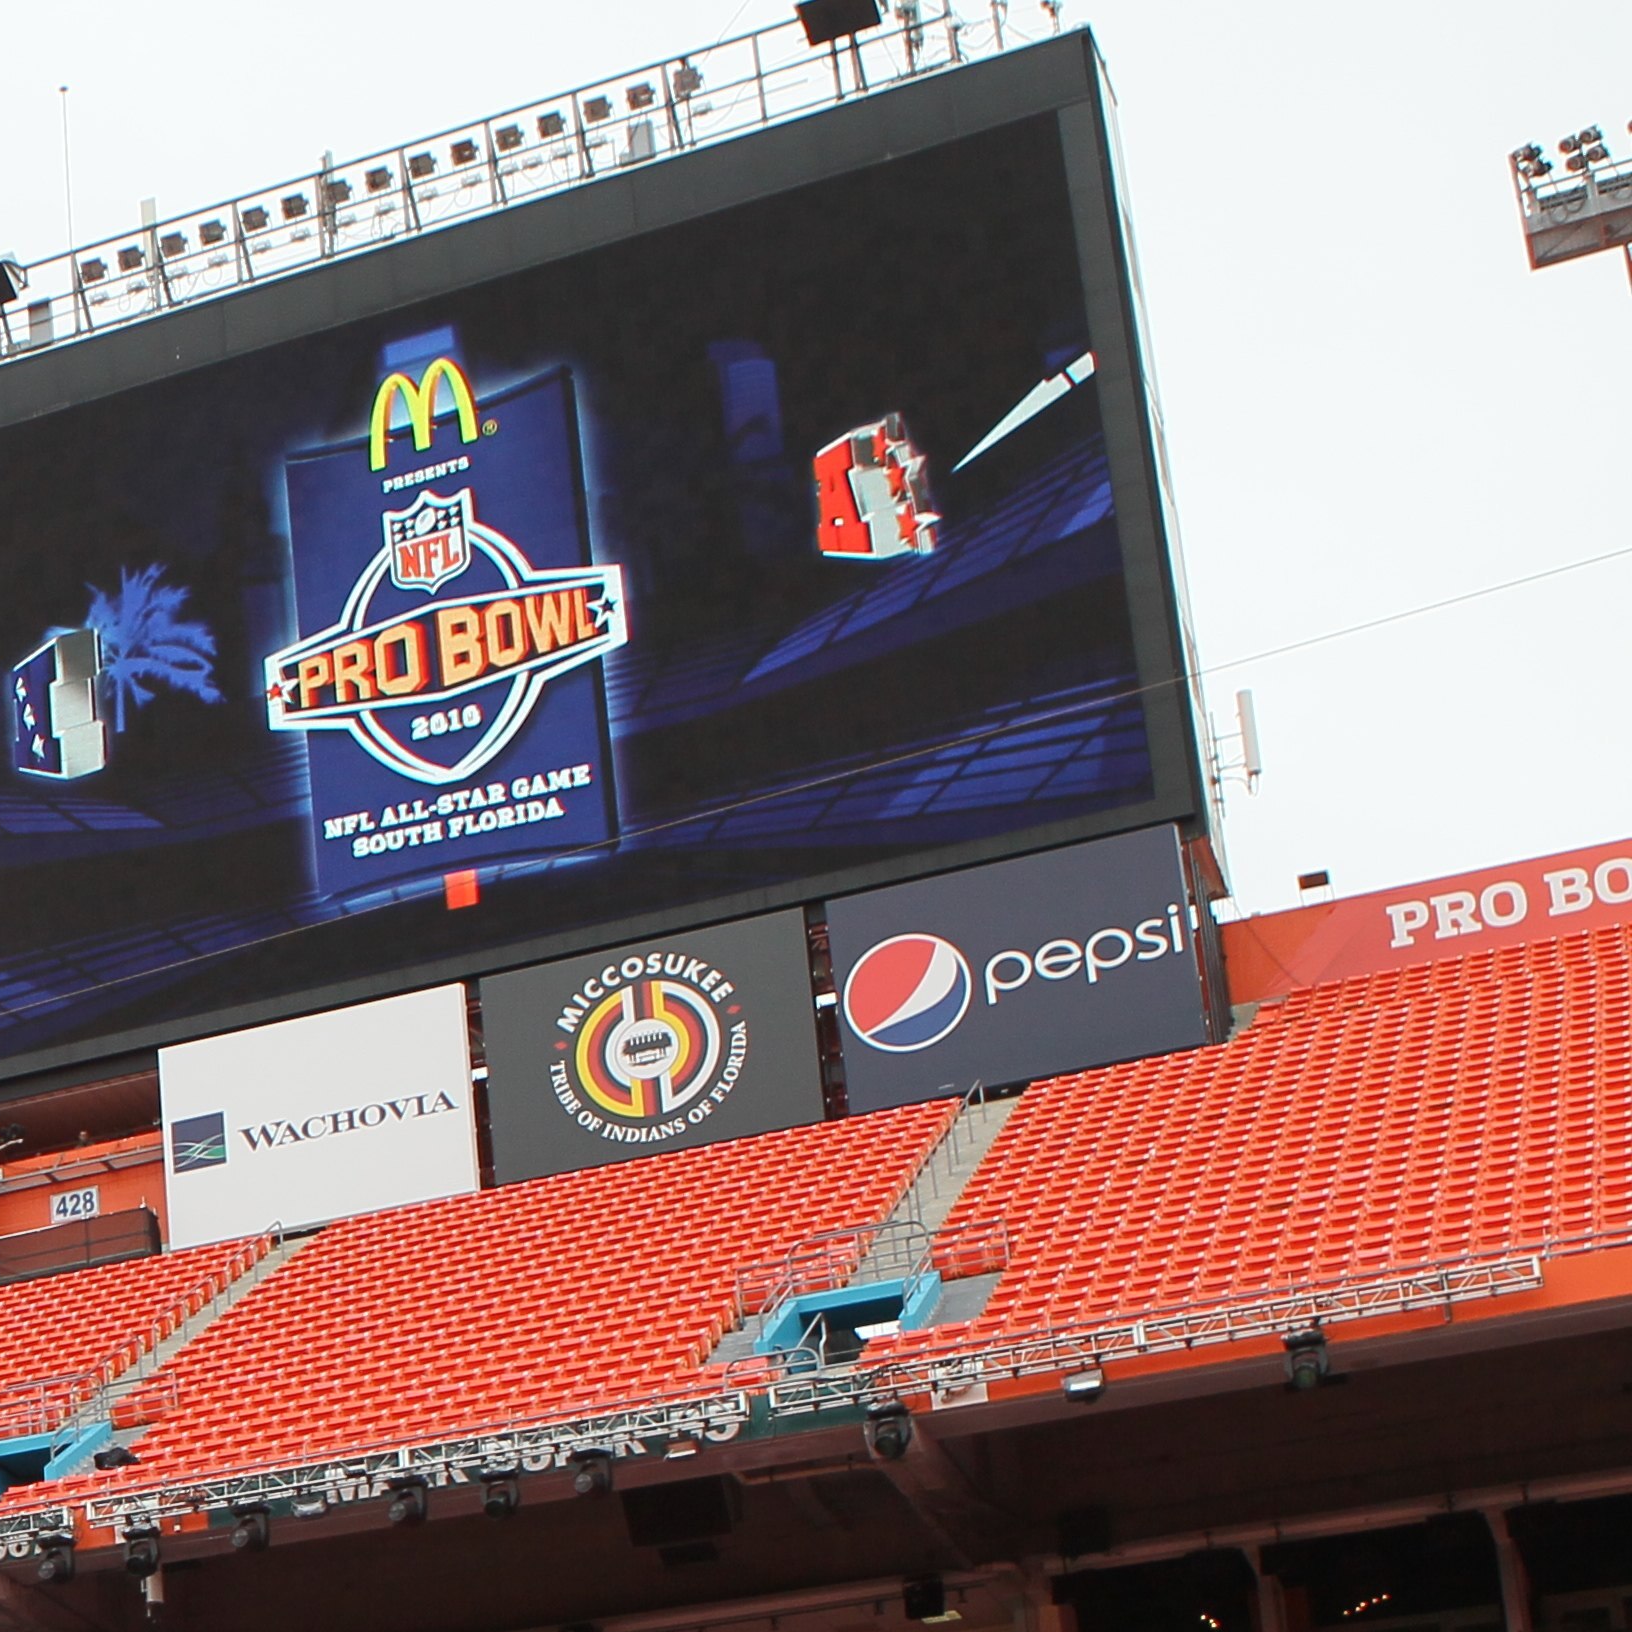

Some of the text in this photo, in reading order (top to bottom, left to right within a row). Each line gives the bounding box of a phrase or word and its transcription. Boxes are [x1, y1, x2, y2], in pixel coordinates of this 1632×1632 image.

[382, 455, 470, 494] PRESENTS
[397, 534, 461, 582] NFL
[298, 585, 596, 710] PRO BOWL
[410, 703, 483, 741] 2010
[323, 764, 593, 841] NFL ALL-STAR GAME
[352, 797, 565, 859] SOUTH FLORIDA
[1386, 881, 1528, 949] PRO
[985, 903, 1185, 1004] pepsi
[556, 952, 735, 1034] MICCOSUKEE
[549, 1020, 748, 1143] TRIBE OF INDIANS OF FLORIDA
[238, 1090, 461, 1152] WACHOVIA
[55, 1190, 96, 1220] 428
